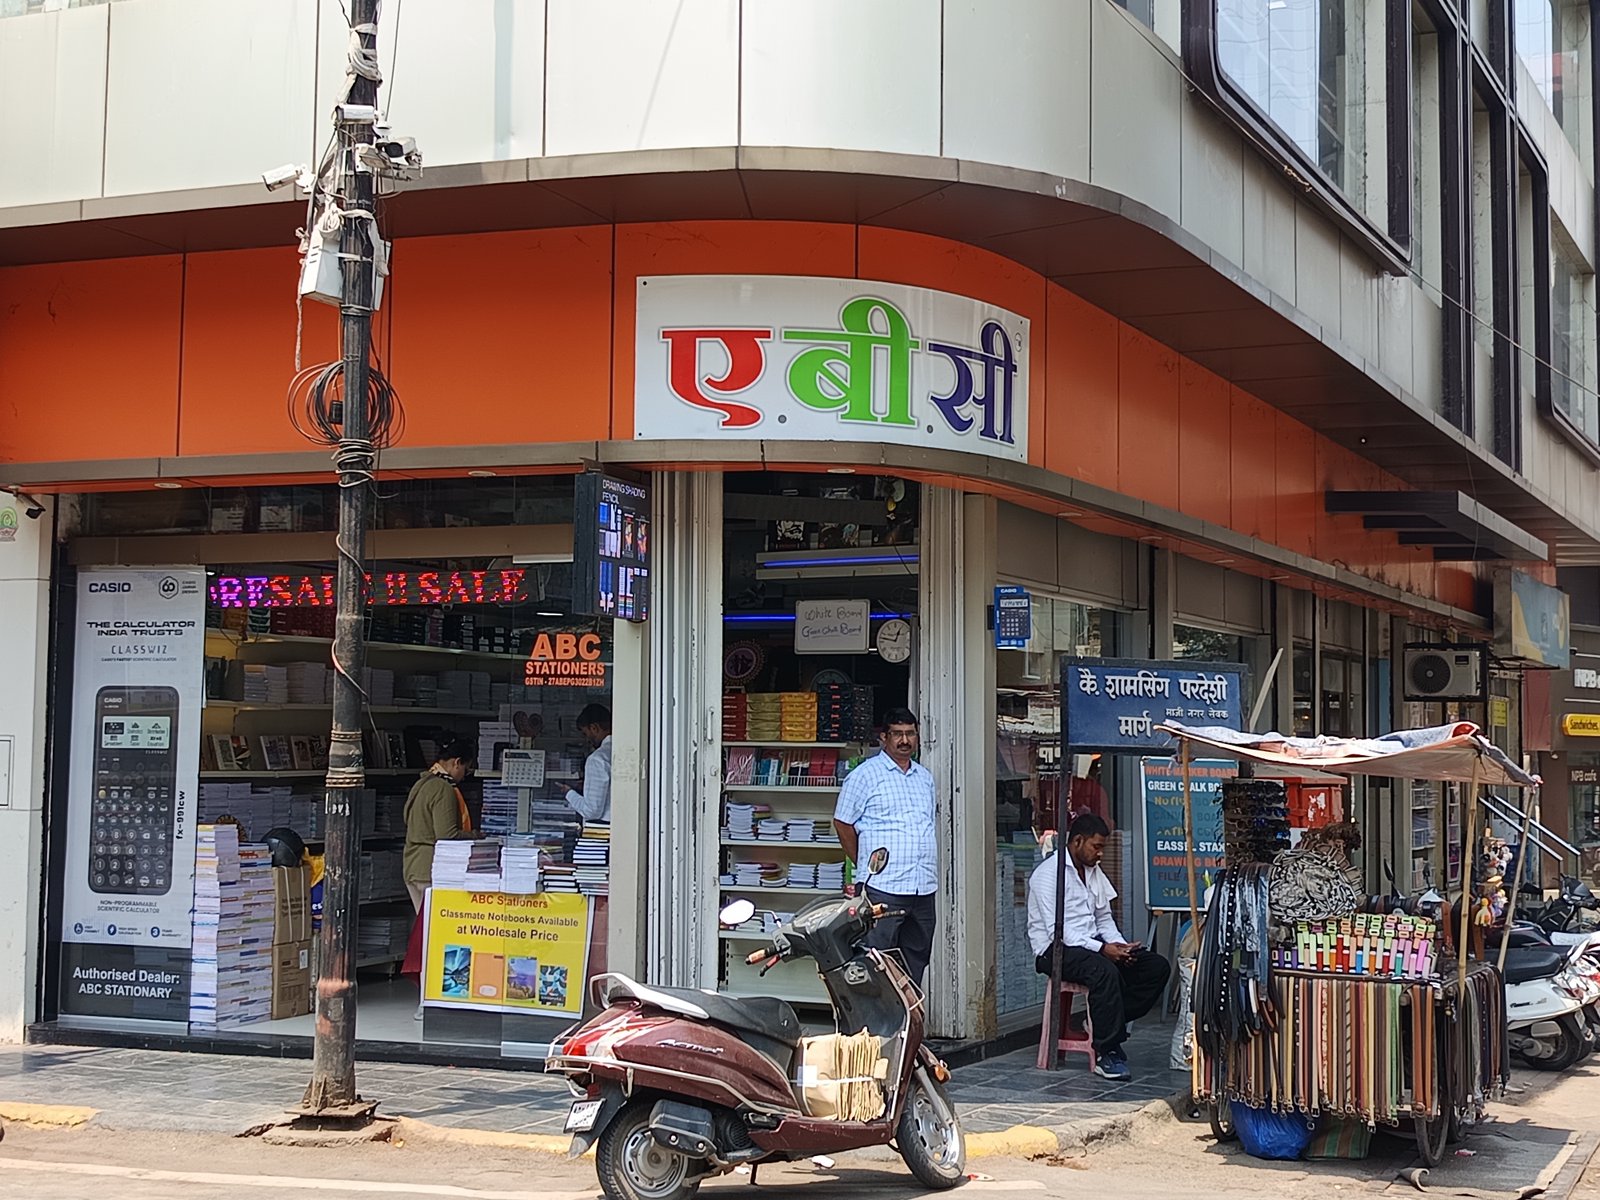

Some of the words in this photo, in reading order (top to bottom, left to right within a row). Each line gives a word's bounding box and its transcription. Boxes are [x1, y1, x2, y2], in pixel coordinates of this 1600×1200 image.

[88, 582, 132, 593] CASIO
[419, 569, 526, 604] SALE
[804, 606, 832, 621] White
[87, 621, 111, 629] THE
[113, 620, 196, 628] CALCULATOR
[97, 629, 128, 637] INDIA
[131, 628, 183, 636] TRUSTS
[111, 645, 168, 655] CLASSWIZ
[530, 633, 601, 661] ABC
[525, 661, 605, 675] STATIONERS
[525, 677, 544, 686] GSTIN
[1104, 670, 1171, 699] शामसिंग
[1179, 673, 1228, 704] परदेशी
[1165, 707, 1184, 718] माजी
[1187, 709, 1205, 719] नगर
[1208, 709, 1229, 719] सेवक
[1118, 710, 1152, 738] मार्ग
[1570, 718, 1598, 731] Sandwiches
[1209, 769, 1239, 778] BOARD
[1571, 770, 1584, 782] NPB
[1147, 780, 1177, 792] GREEN
[1178, 782, 1207, 792] CALK
[1152, 856, 1202, 867] DRAWIG
[470, 894, 494, 905] ABC
[497, 895, 549, 909] Stationers
[125, 906, 160, 914] CALCULATOR
[440, 908, 485, 920] Classmate
[487, 912, 536, 924] Notebooks
[537, 915, 579, 927] Available
[457, 925, 467, 935] at
[470, 925, 527, 939] Wholesale
[530, 929, 559, 942] Price
[73, 966, 136, 982] Authorised
[139, 969, 180, 984] Dealer:
[79, 983, 102, 995] ABC
[105, 984, 172, 998] STATIONARY
